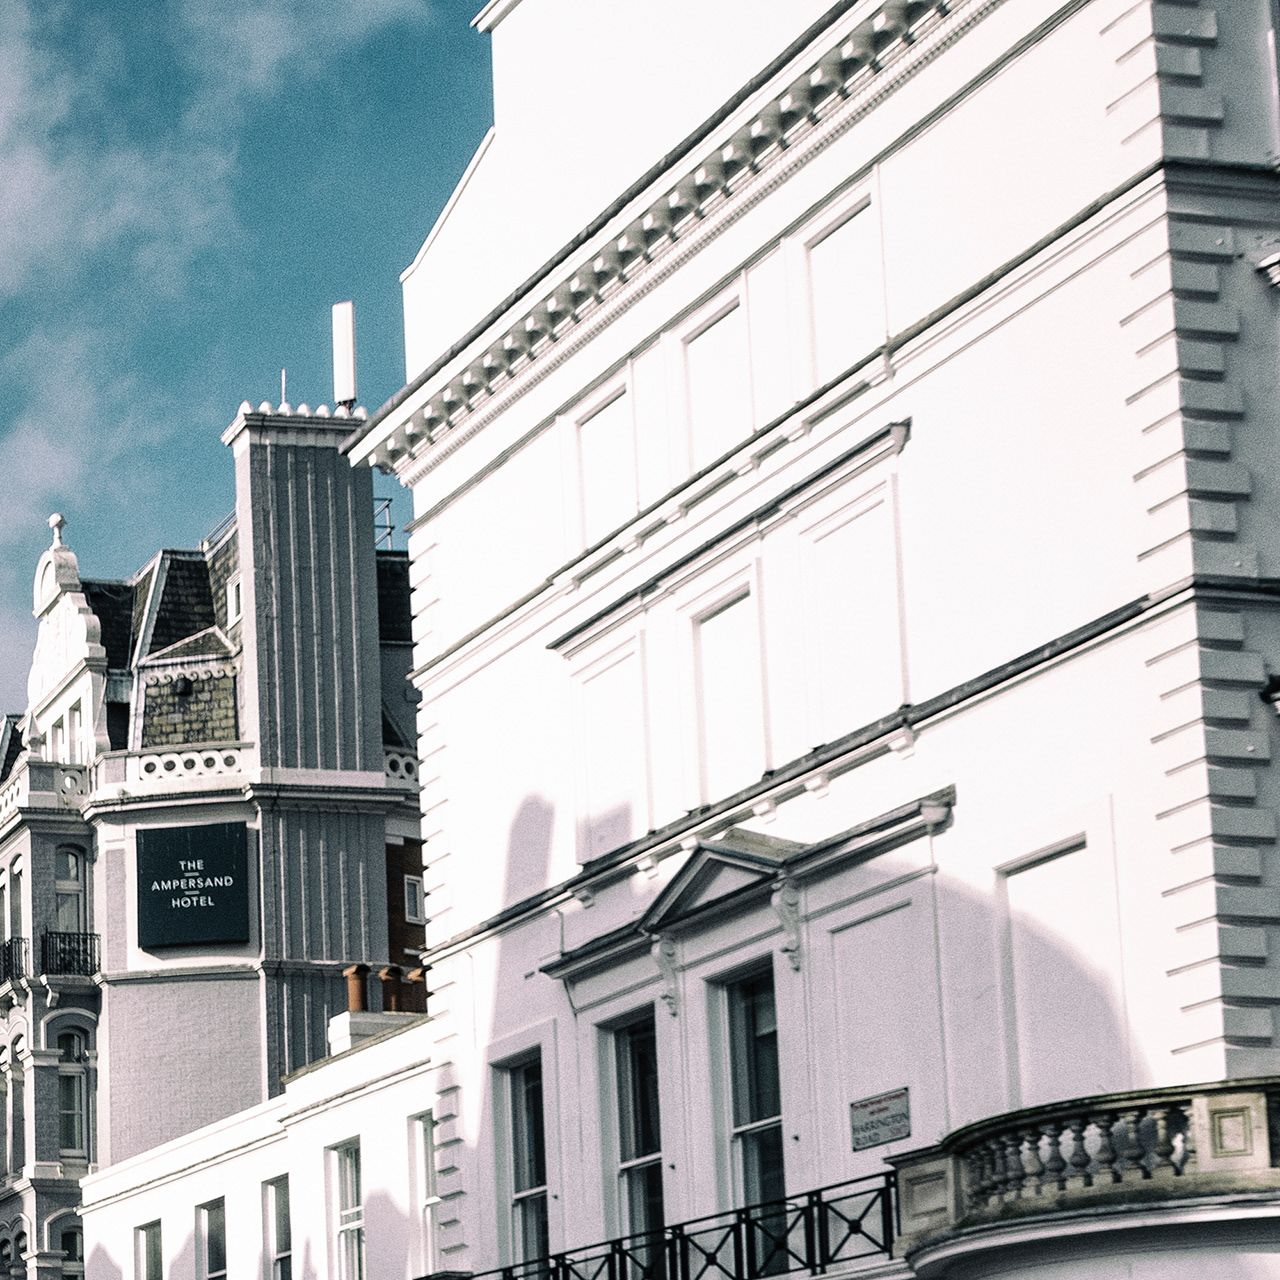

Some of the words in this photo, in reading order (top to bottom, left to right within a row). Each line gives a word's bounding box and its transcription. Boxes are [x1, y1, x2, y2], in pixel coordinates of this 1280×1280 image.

[178, 859, 205, 871] THE
[151, 875, 234, 892] AMPERSAND
[171, 896, 215, 908] HOTEL
